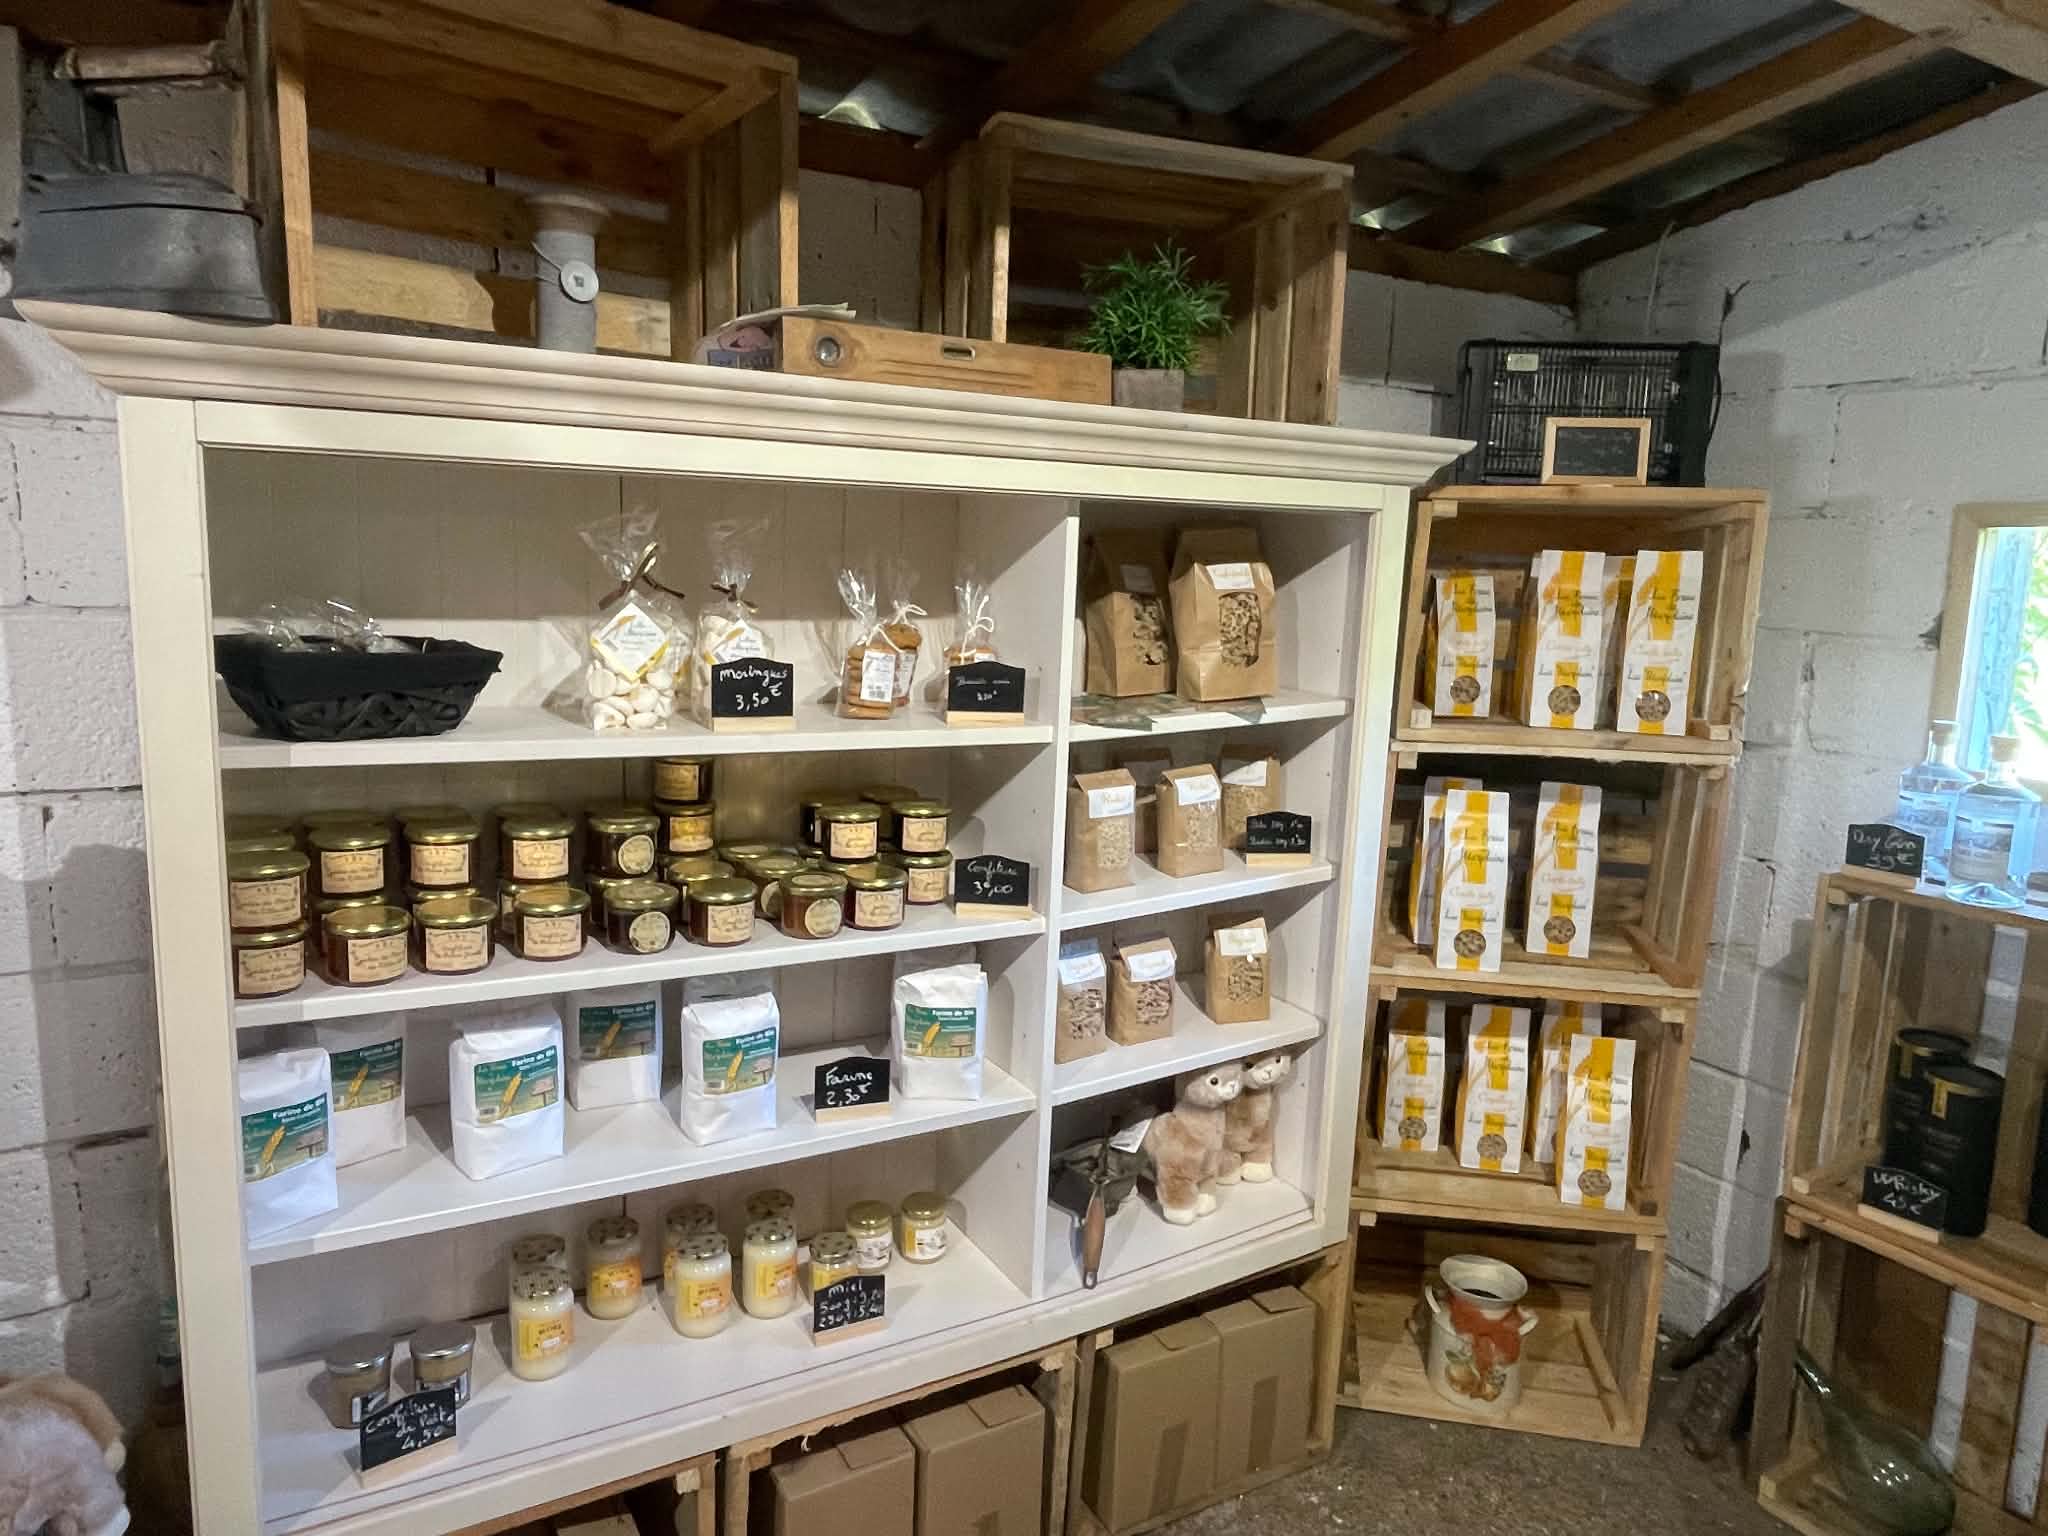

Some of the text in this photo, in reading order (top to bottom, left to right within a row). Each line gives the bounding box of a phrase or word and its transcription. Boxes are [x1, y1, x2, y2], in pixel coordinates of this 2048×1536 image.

[511, 1056, 535, 1068] Farine
[826, 1066, 873, 1086] Farine
[272, 1107, 302, 1120] Farine
